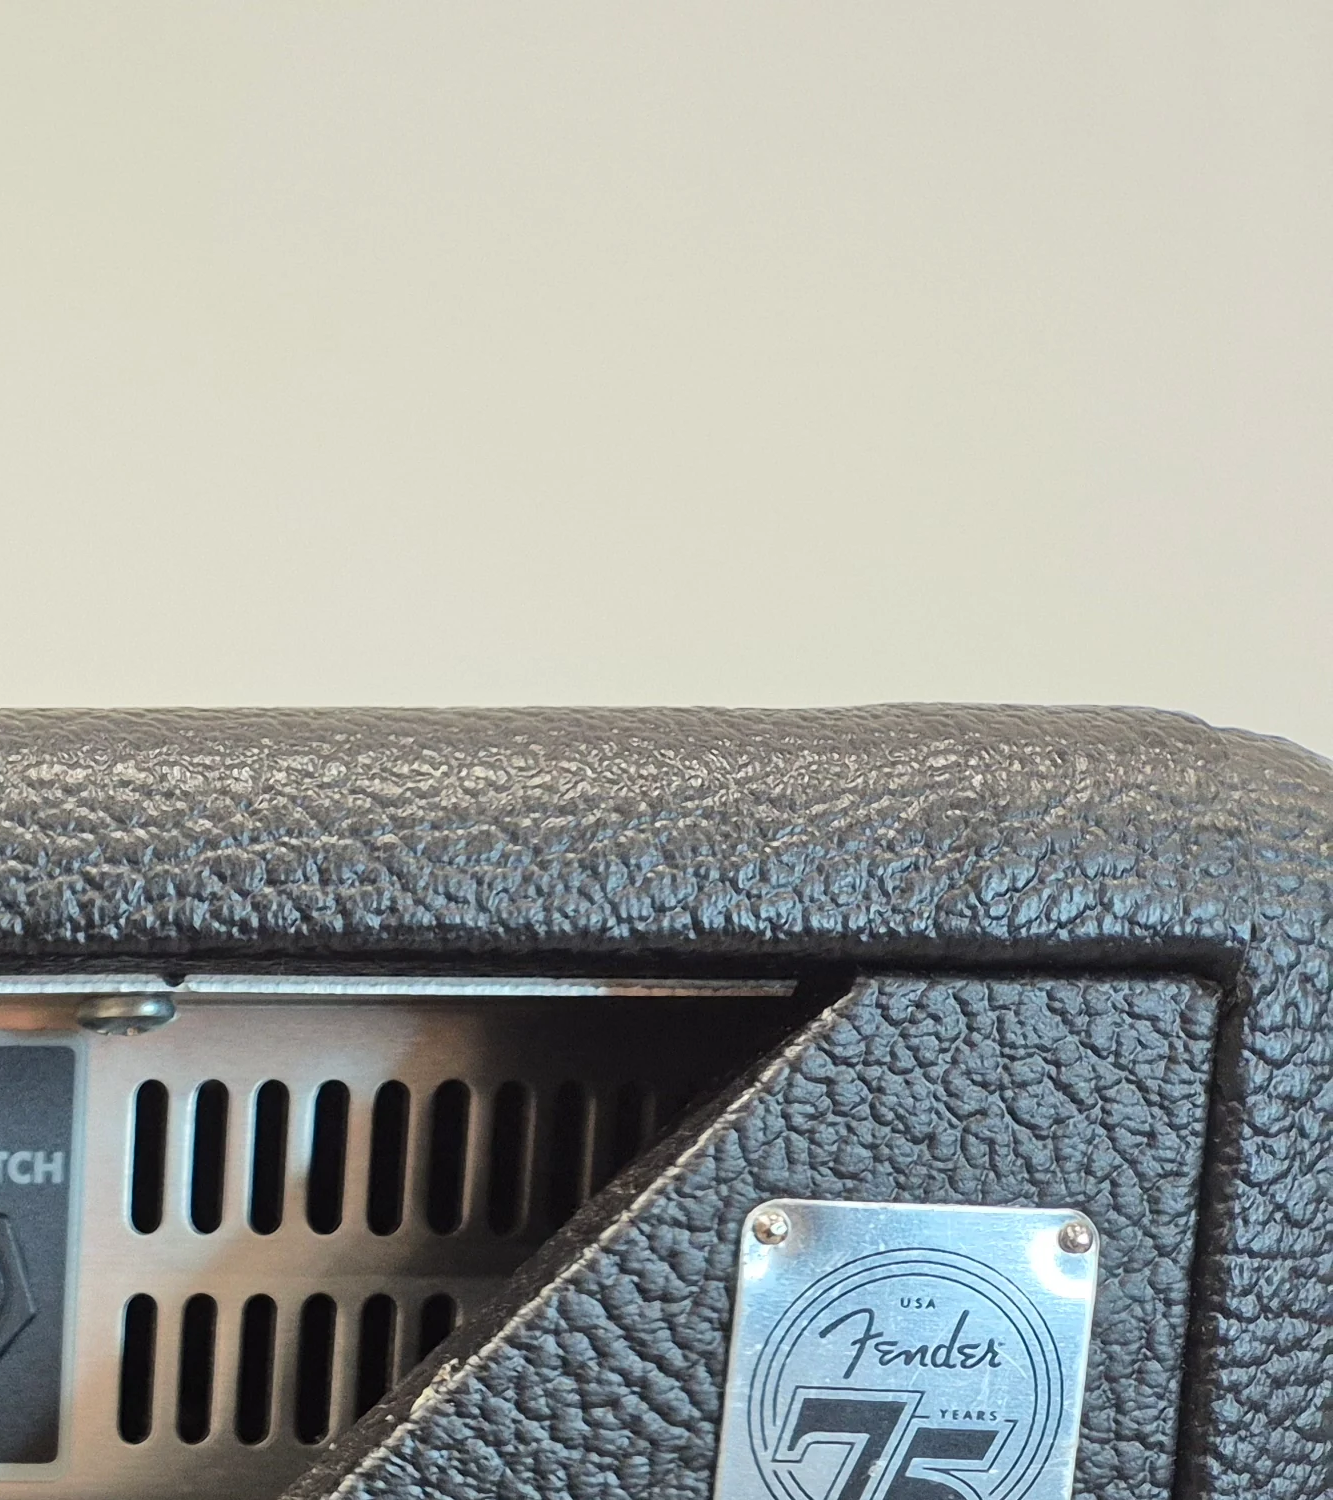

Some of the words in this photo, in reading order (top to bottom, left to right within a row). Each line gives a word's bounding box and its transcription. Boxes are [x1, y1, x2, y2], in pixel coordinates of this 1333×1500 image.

[899, 1296, 938, 1310] USA
[818, 1307, 1005, 1380] Fender
[938, 1407, 1000, 1422] YEARS
